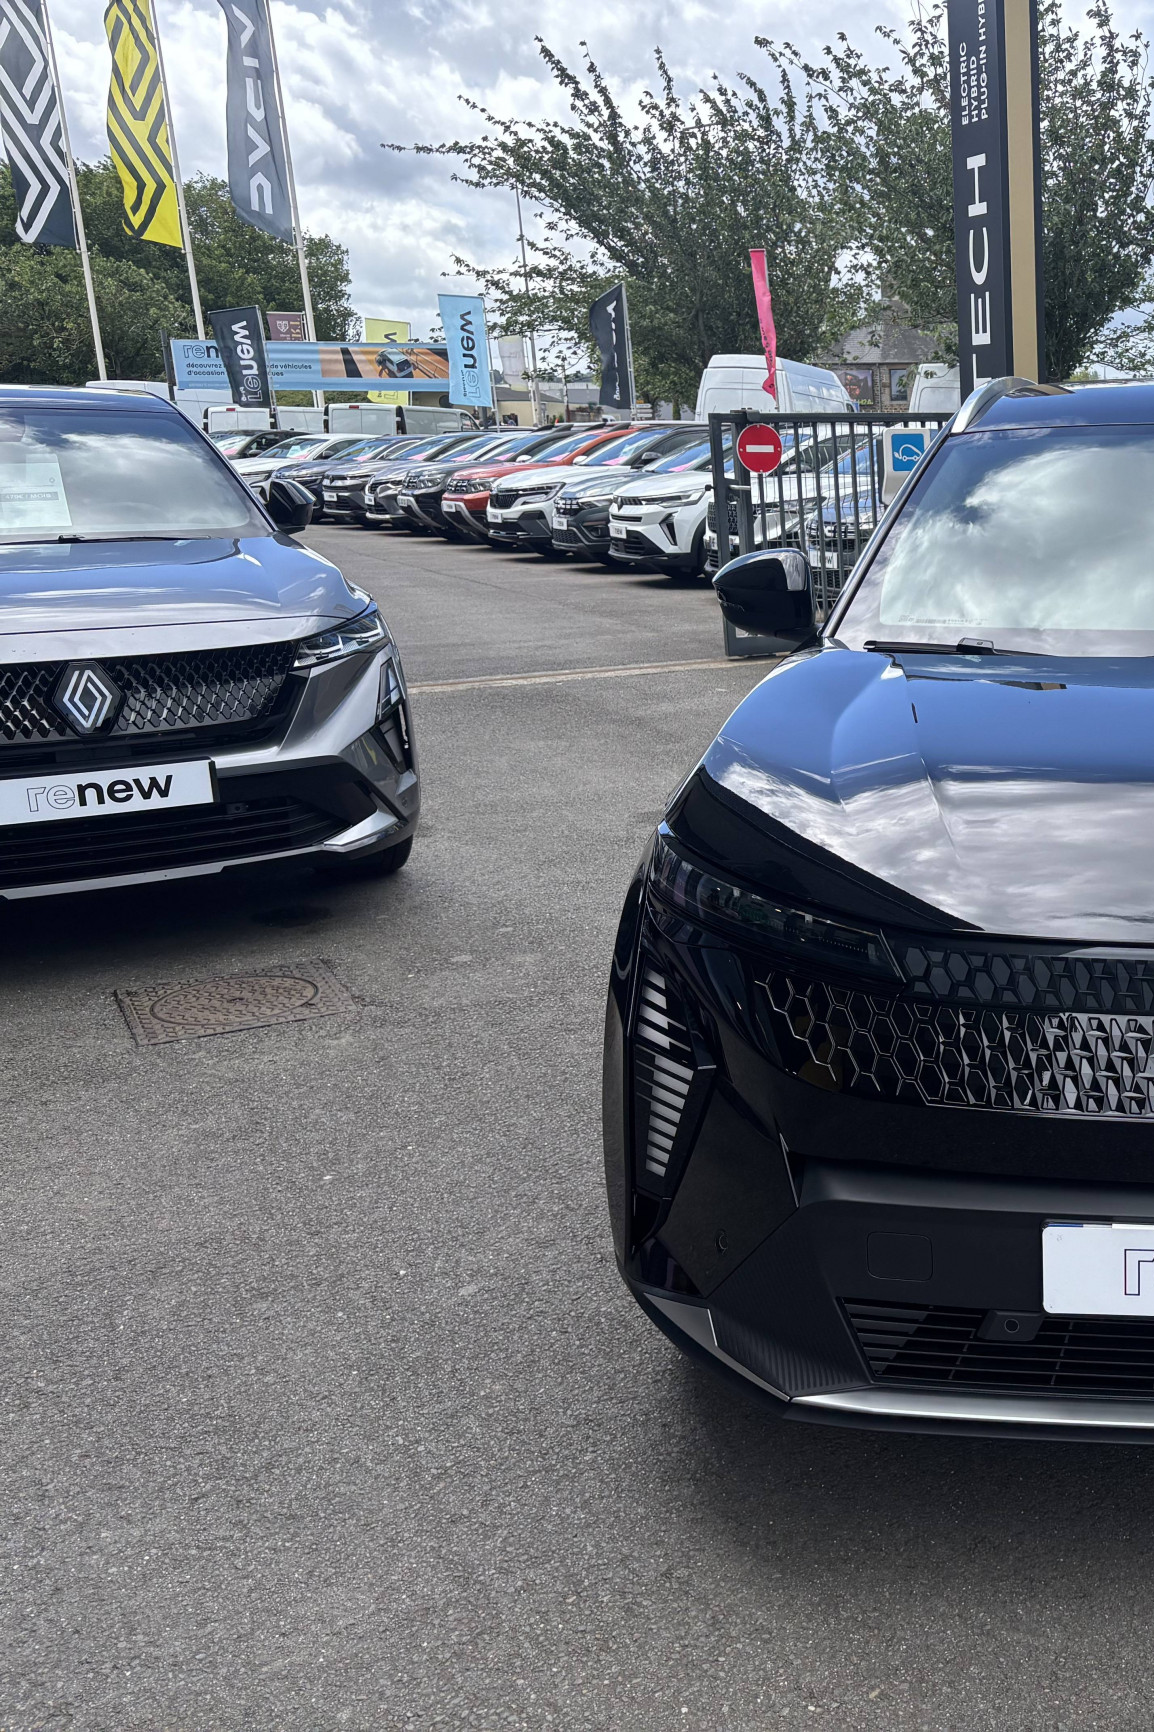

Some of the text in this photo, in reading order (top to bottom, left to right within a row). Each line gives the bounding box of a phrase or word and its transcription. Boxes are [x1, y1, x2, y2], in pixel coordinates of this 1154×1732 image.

[960, 42, 969, 125] ELECTRIC
[970, 56, 979, 122] HYBRID
[977, 0, 988, 120] PLUG-IN HYB
[183, 345, 220, 359] ren
[26, 774, 173, 812] renew
